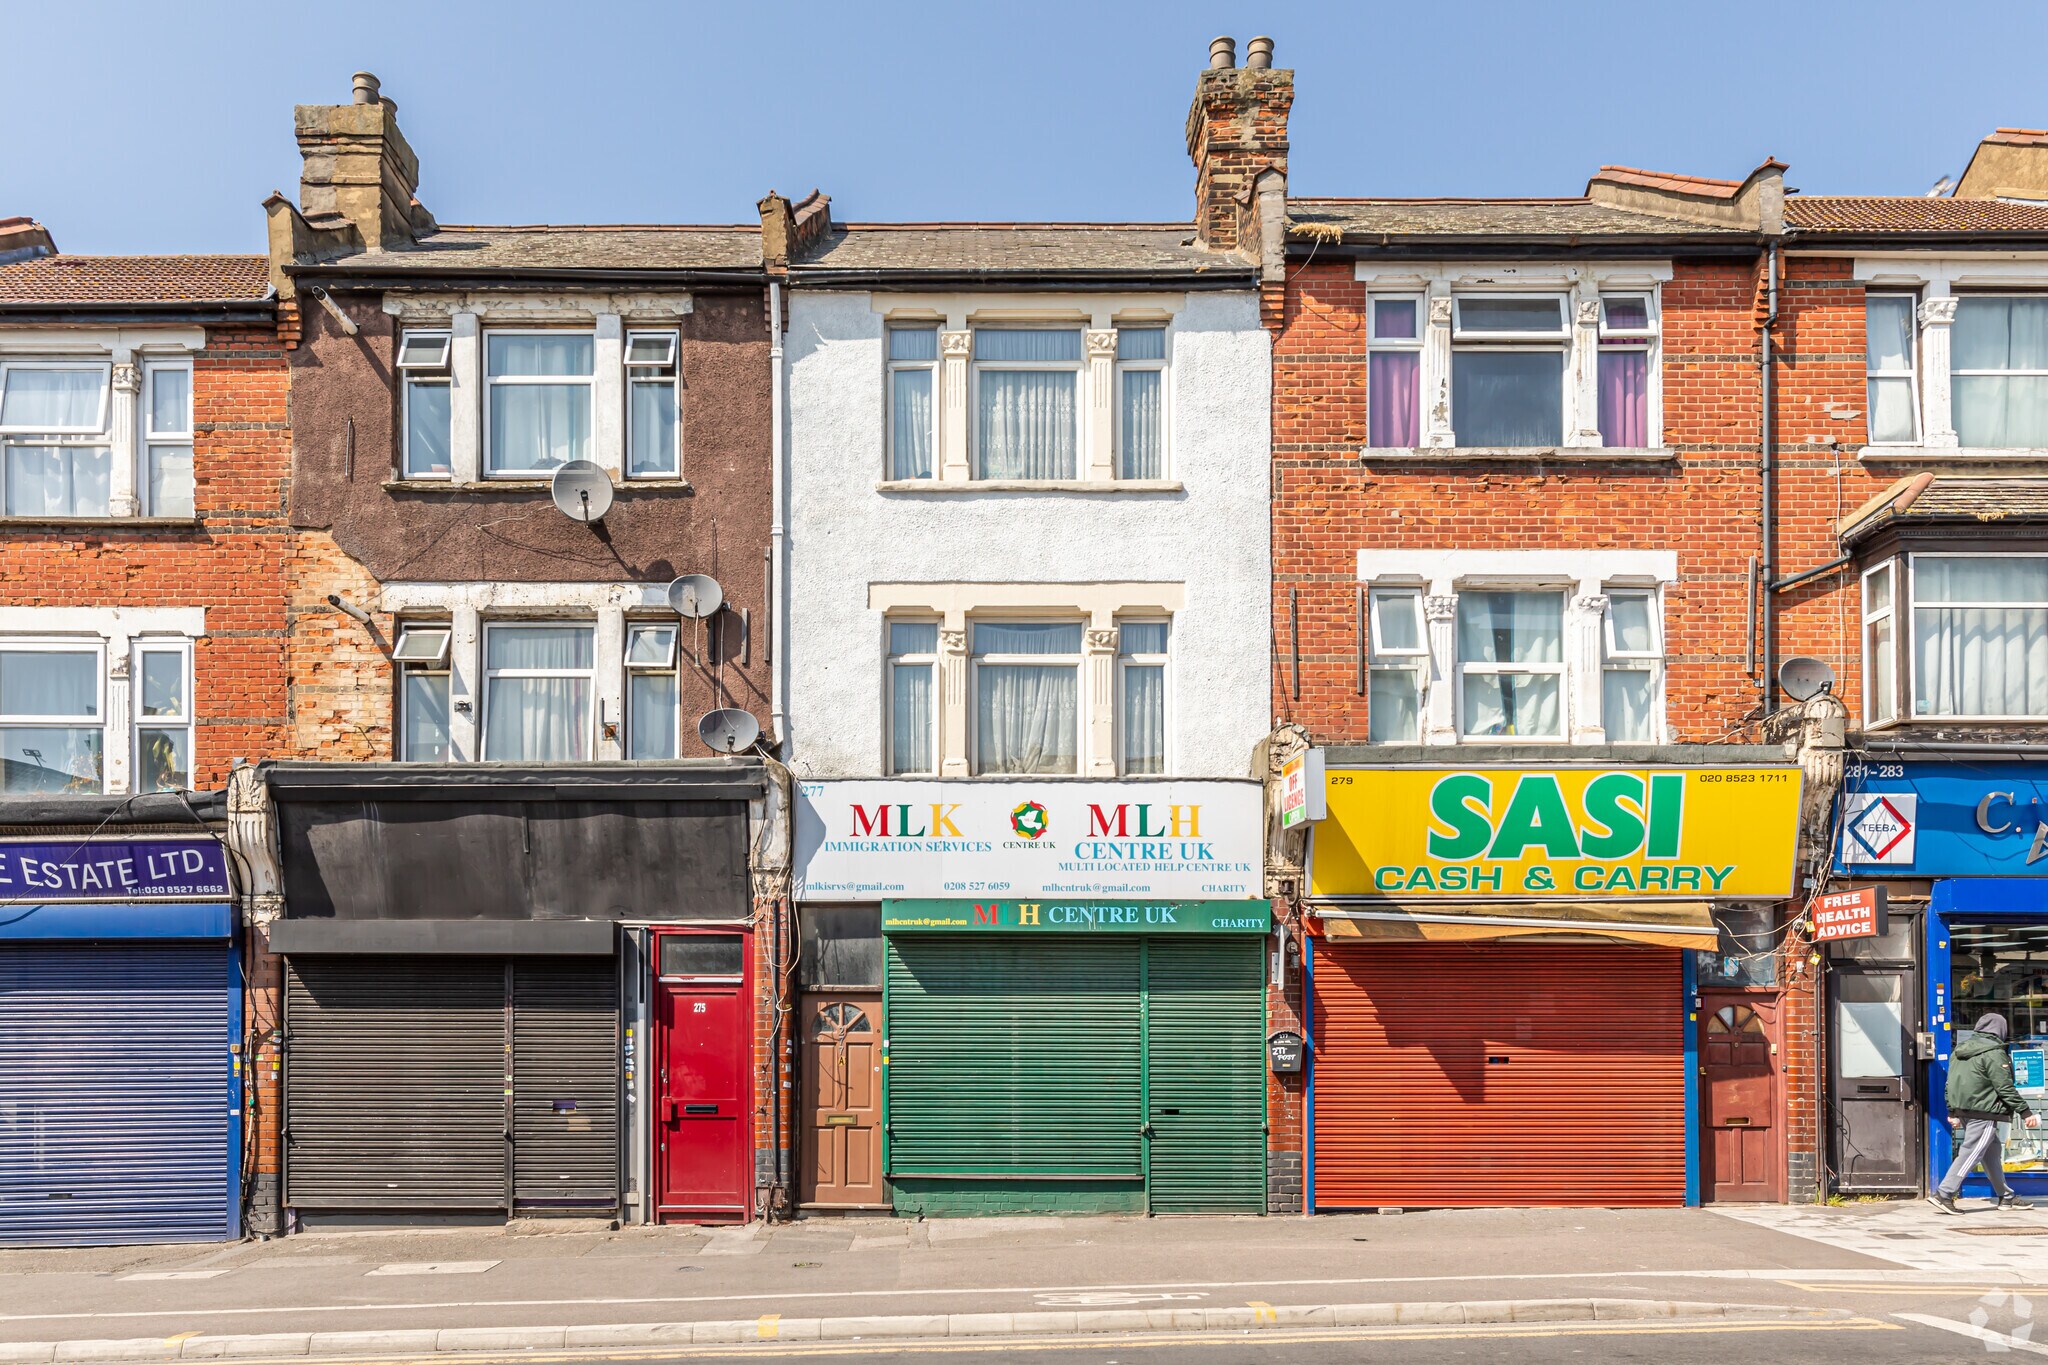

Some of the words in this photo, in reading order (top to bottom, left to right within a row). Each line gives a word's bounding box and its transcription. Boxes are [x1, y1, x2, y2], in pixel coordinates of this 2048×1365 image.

[1288, 773, 1298, 792] OFF
[1331, 777, 1353, 785] 279
[1699, 774, 1723, 784] 020
[1725, 774, 1756, 784] 8523
[1759, 774, 1789, 783] 1711
[801, 785, 825, 797] 277
[849, 803, 964, 837] MLK
[1086, 803, 1203, 838] MLH
[1426, 771, 1687, 861] SASI
[1861, 823, 1898, 832] TEEBA
[824, 841, 922, 852] IMMIGRATION
[925, 841, 992, 852] SERVICES
[1002, 841, 1040, 849] CENTRE
[1042, 841, 1056, 849] UK
[1074, 842, 1173, 860] CENTRE
[1180, 842, 1215, 860] UK
[20, 857, 139, 890] ESTATE
[147, 849, 215, 880] LTD.
[1058, 862, 1095, 872] MULTI
[1097, 863, 1151, 872] LOCATED
[1154, 863, 1185, 872] HELP
[1186, 863, 1232, 872] CENTRE
[1235, 863, 1252, 872] UK
[1374, 864, 1502, 891] CASH
[1523, 865, 1557, 891] &
[1574, 864, 1737, 891] CARRY
[126, 886, 165, 894] Tel:020
[167, 886, 193, 894] 8527
[196, 885, 224, 893] 6662
[805, 881, 905, 893] mlkisrvs@gmail.com
[944, 881, 967, 891] 0208
[968, 881, 986, 891] 527
[987, 881, 1011, 891] 6059
[1042, 883, 1151, 893] mlhcntruk@gmail.com
[1201, 884, 1246, 893] CHARITY
[1824, 893, 1861, 908] FREE
[972, 903, 1041, 926] MLH
[1048, 906, 1139, 924] CENTRE
[1144, 906, 1178, 924] UK
[1211, 918, 1265, 929] CHARITY
[1816, 907, 1870, 923] HEALTH
[1817, 921, 1871, 938] ADVICE
[693, 1002, 706, 1013] 275
